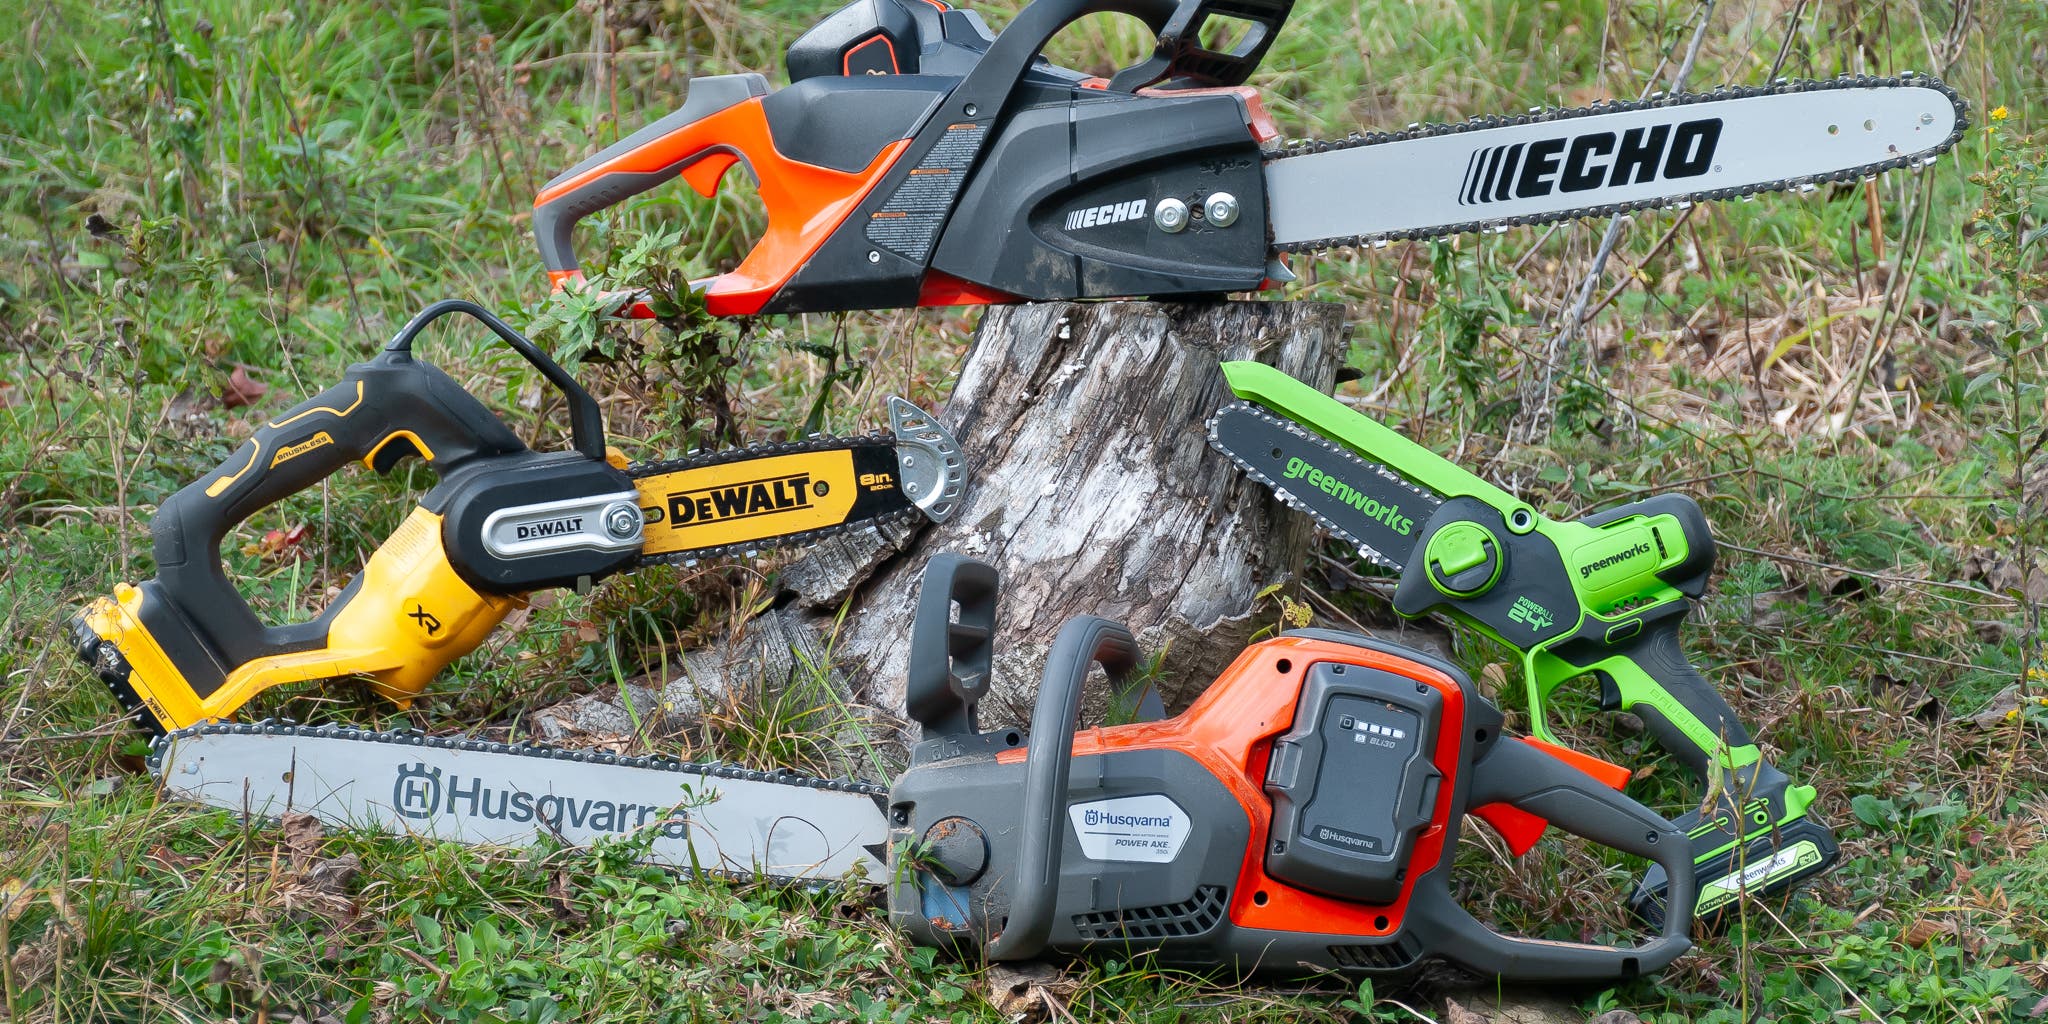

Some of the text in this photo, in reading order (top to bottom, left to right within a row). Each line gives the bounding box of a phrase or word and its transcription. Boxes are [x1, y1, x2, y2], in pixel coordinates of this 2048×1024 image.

[1515, 118, 1724, 199] ECHO
[1082, 199, 1147, 228] ECHO
[278, 436, 328, 460] BRUSHLESS
[1283, 457, 1415, 537] greenworks
[1580, 541, 1651, 579] greenworks
[1507, 602, 1554, 632] 24V
[1517, 595, 1554, 622] POWERALL
[446, 775, 689, 840] Husqvarna
[1100, 812, 1170, 828] Husqvarna
[1115, 838, 1169, 849] POWER AXE
[1329, 831, 1374, 849] Husqvarna
